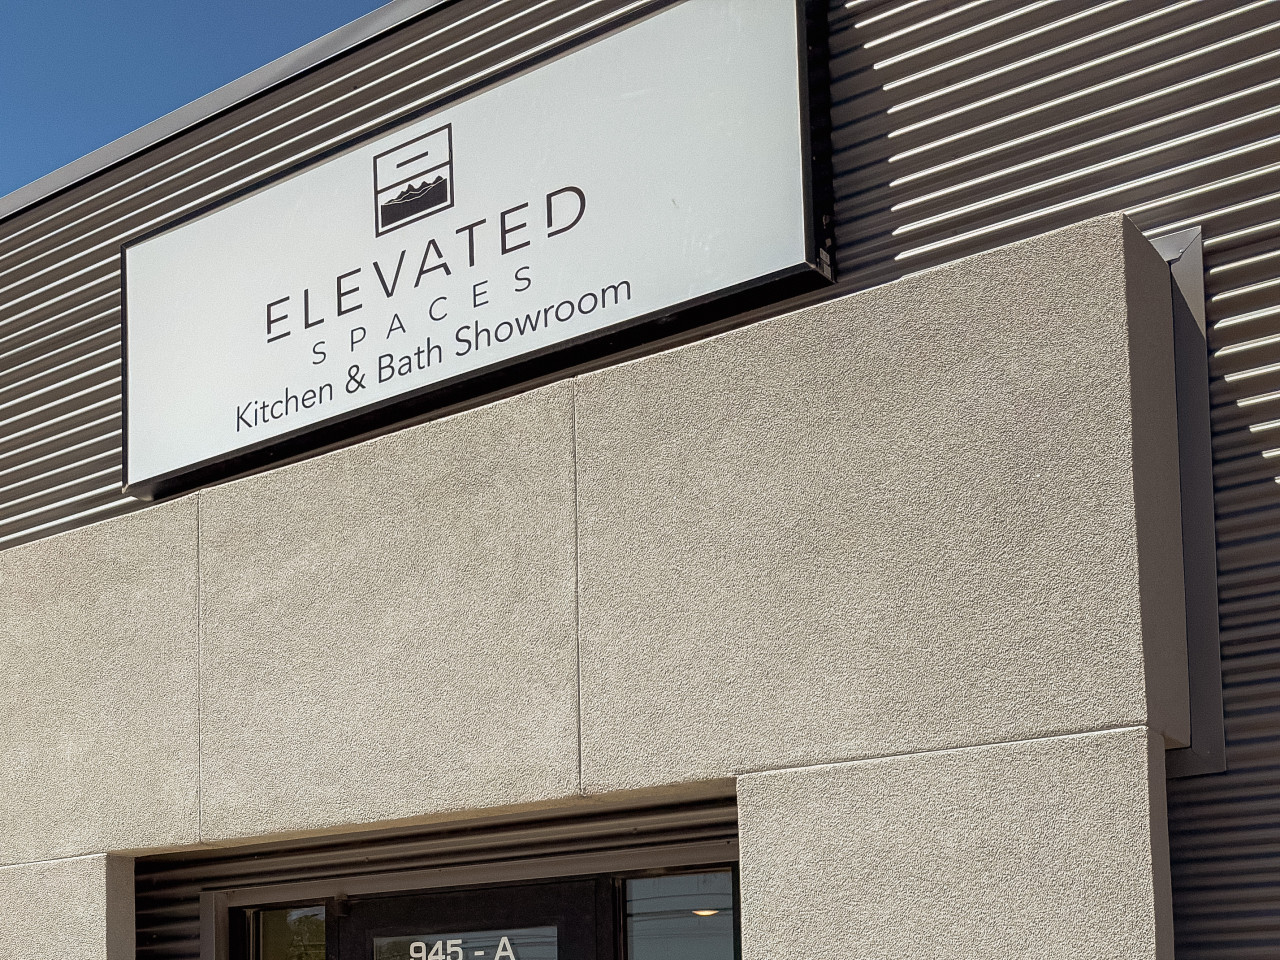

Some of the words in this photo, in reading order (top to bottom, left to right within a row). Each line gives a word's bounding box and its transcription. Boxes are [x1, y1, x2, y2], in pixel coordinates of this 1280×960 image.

[265, 185, 587, 344] ELEVATED
[311, 265, 532, 365] SPACES
[235, 380, 333, 432] Kitchen
[344, 364, 367, 394] &
[377, 336, 442, 384] Bath
[454, 279, 632, 357] Showroom
